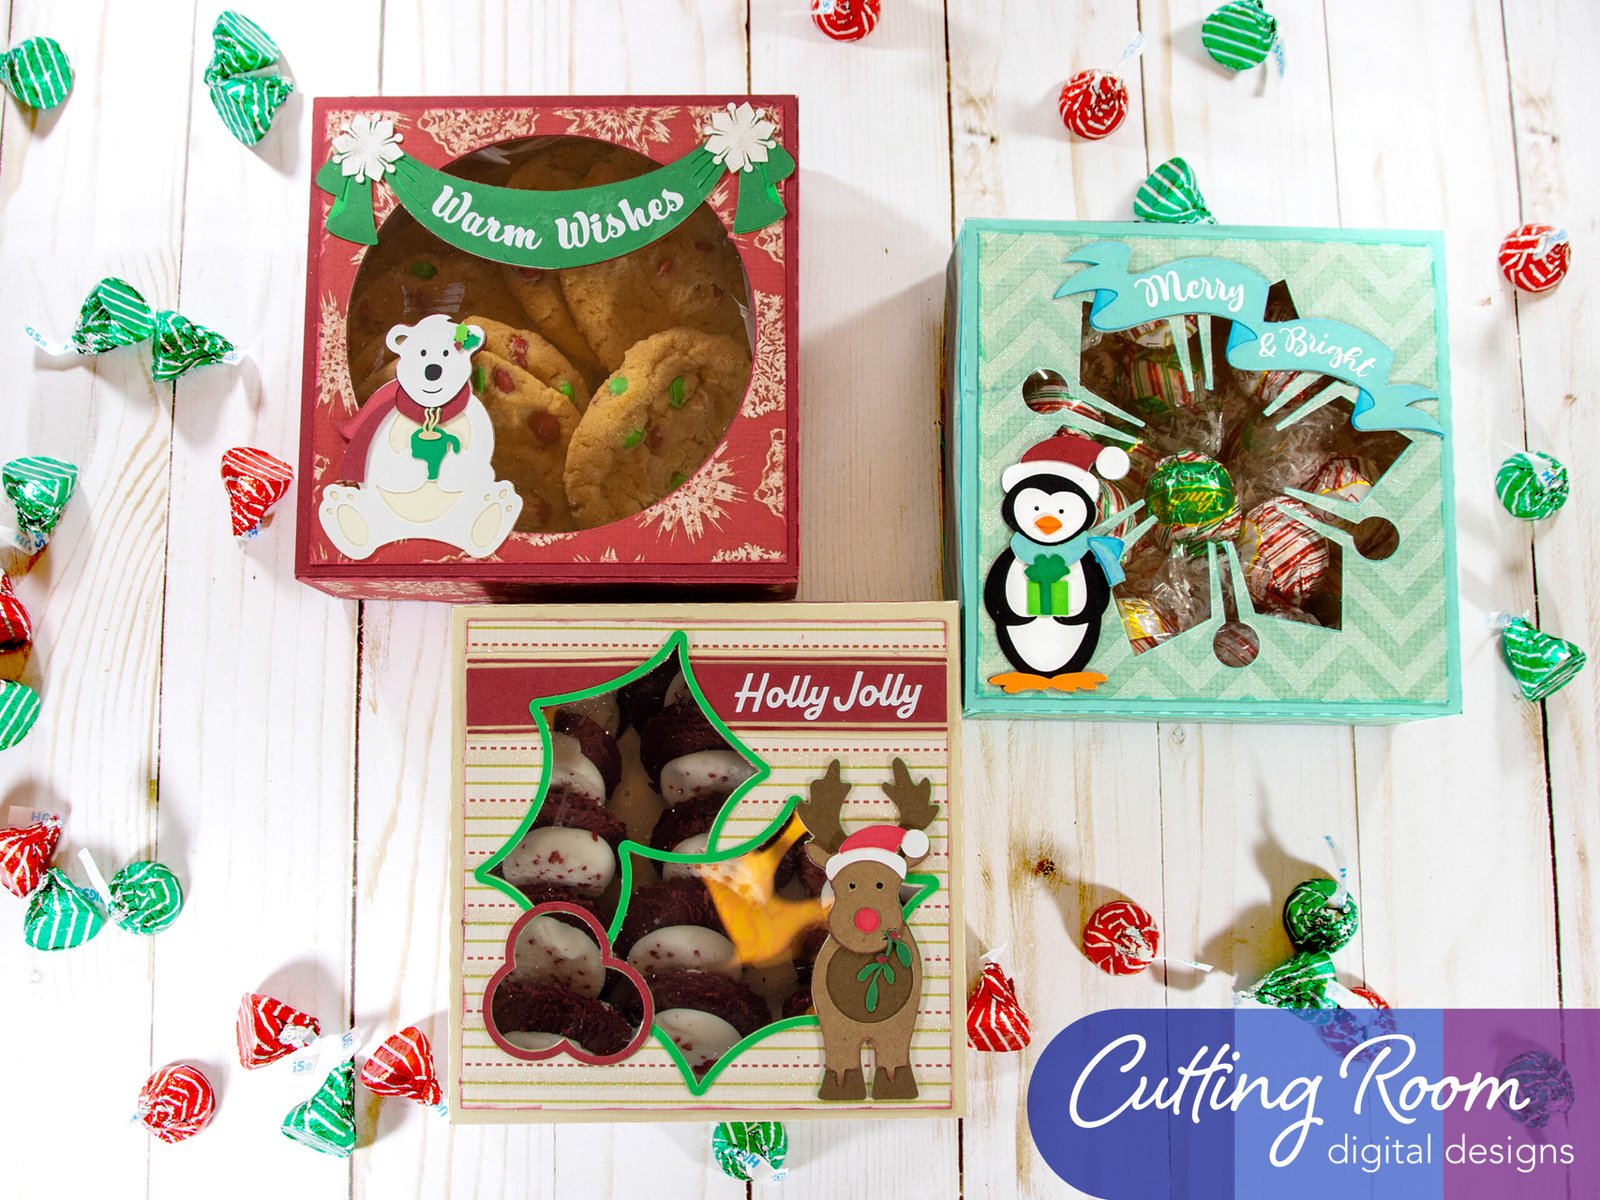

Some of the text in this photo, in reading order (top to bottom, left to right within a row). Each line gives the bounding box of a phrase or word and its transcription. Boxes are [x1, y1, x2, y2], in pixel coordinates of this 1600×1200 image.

[431, 184, 684, 250] Warm Wishes
[1134, 271, 1245, 312] Merry
[1259, 326, 1376, 378] & Bright
[734, 671, 923, 721] Holly Jolly
